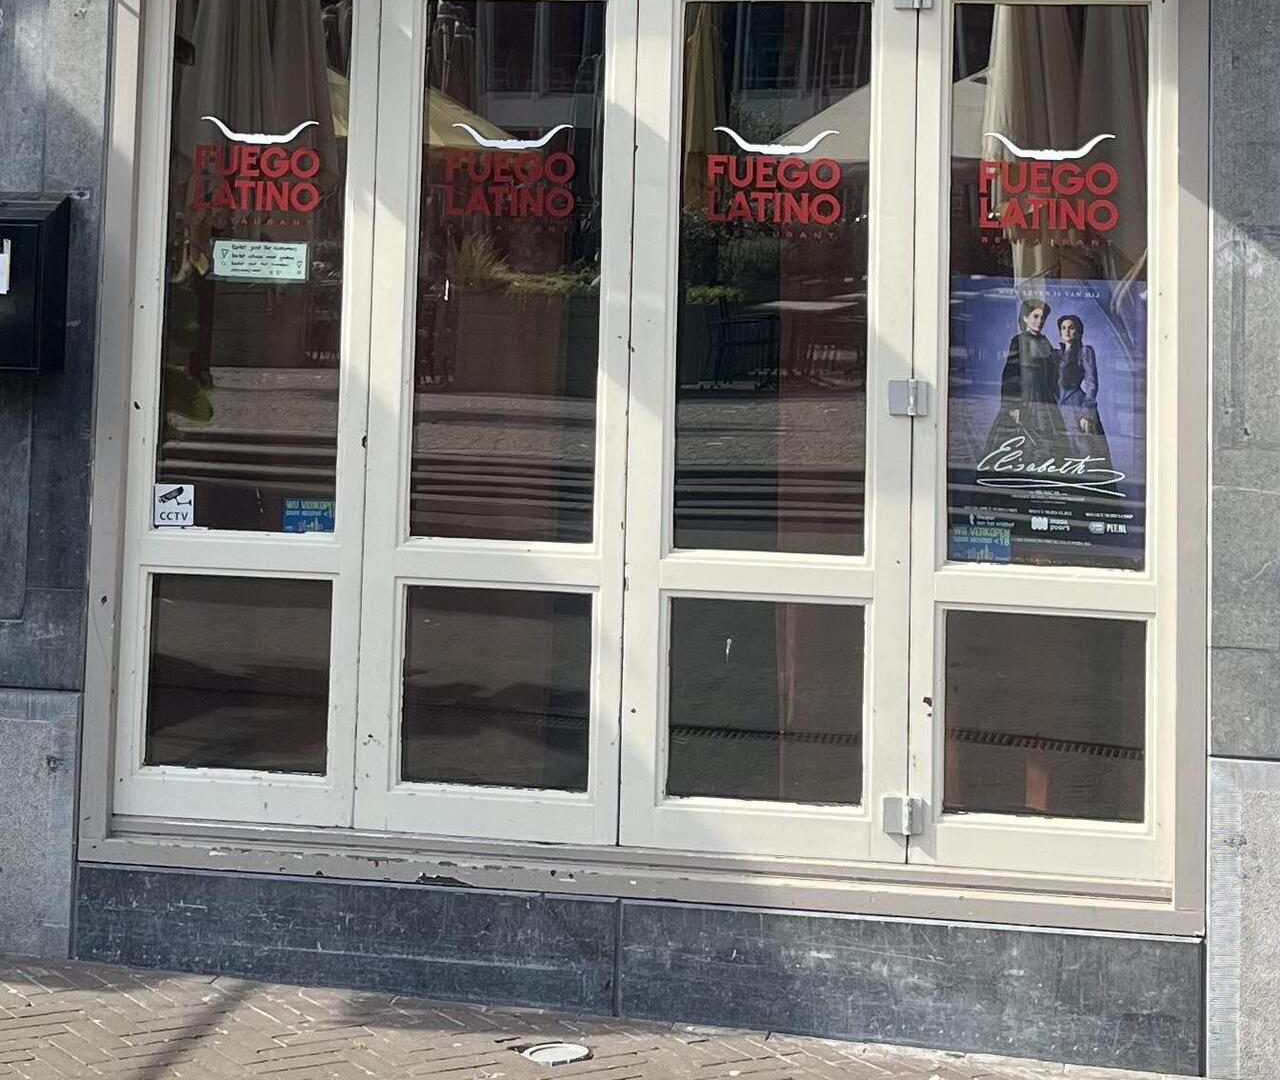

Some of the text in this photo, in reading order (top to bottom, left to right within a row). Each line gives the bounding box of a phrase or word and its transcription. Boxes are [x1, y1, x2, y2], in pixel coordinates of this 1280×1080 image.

[193, 143, 320, 179] FUEGO
[446, 149, 576, 184] FUEGO
[706, 154, 842, 190] FUEGO
[978, 160, 1119, 196] FUEGO
[192, 179, 320, 212] LATINO
[446, 184, 575, 217] LATINO
[706, 190, 842, 225] LATINO
[978, 196, 1120, 232] LATINO
[977, 436, 1125, 487] Elisabeth
[159, 511, 189, 520] CCTV
